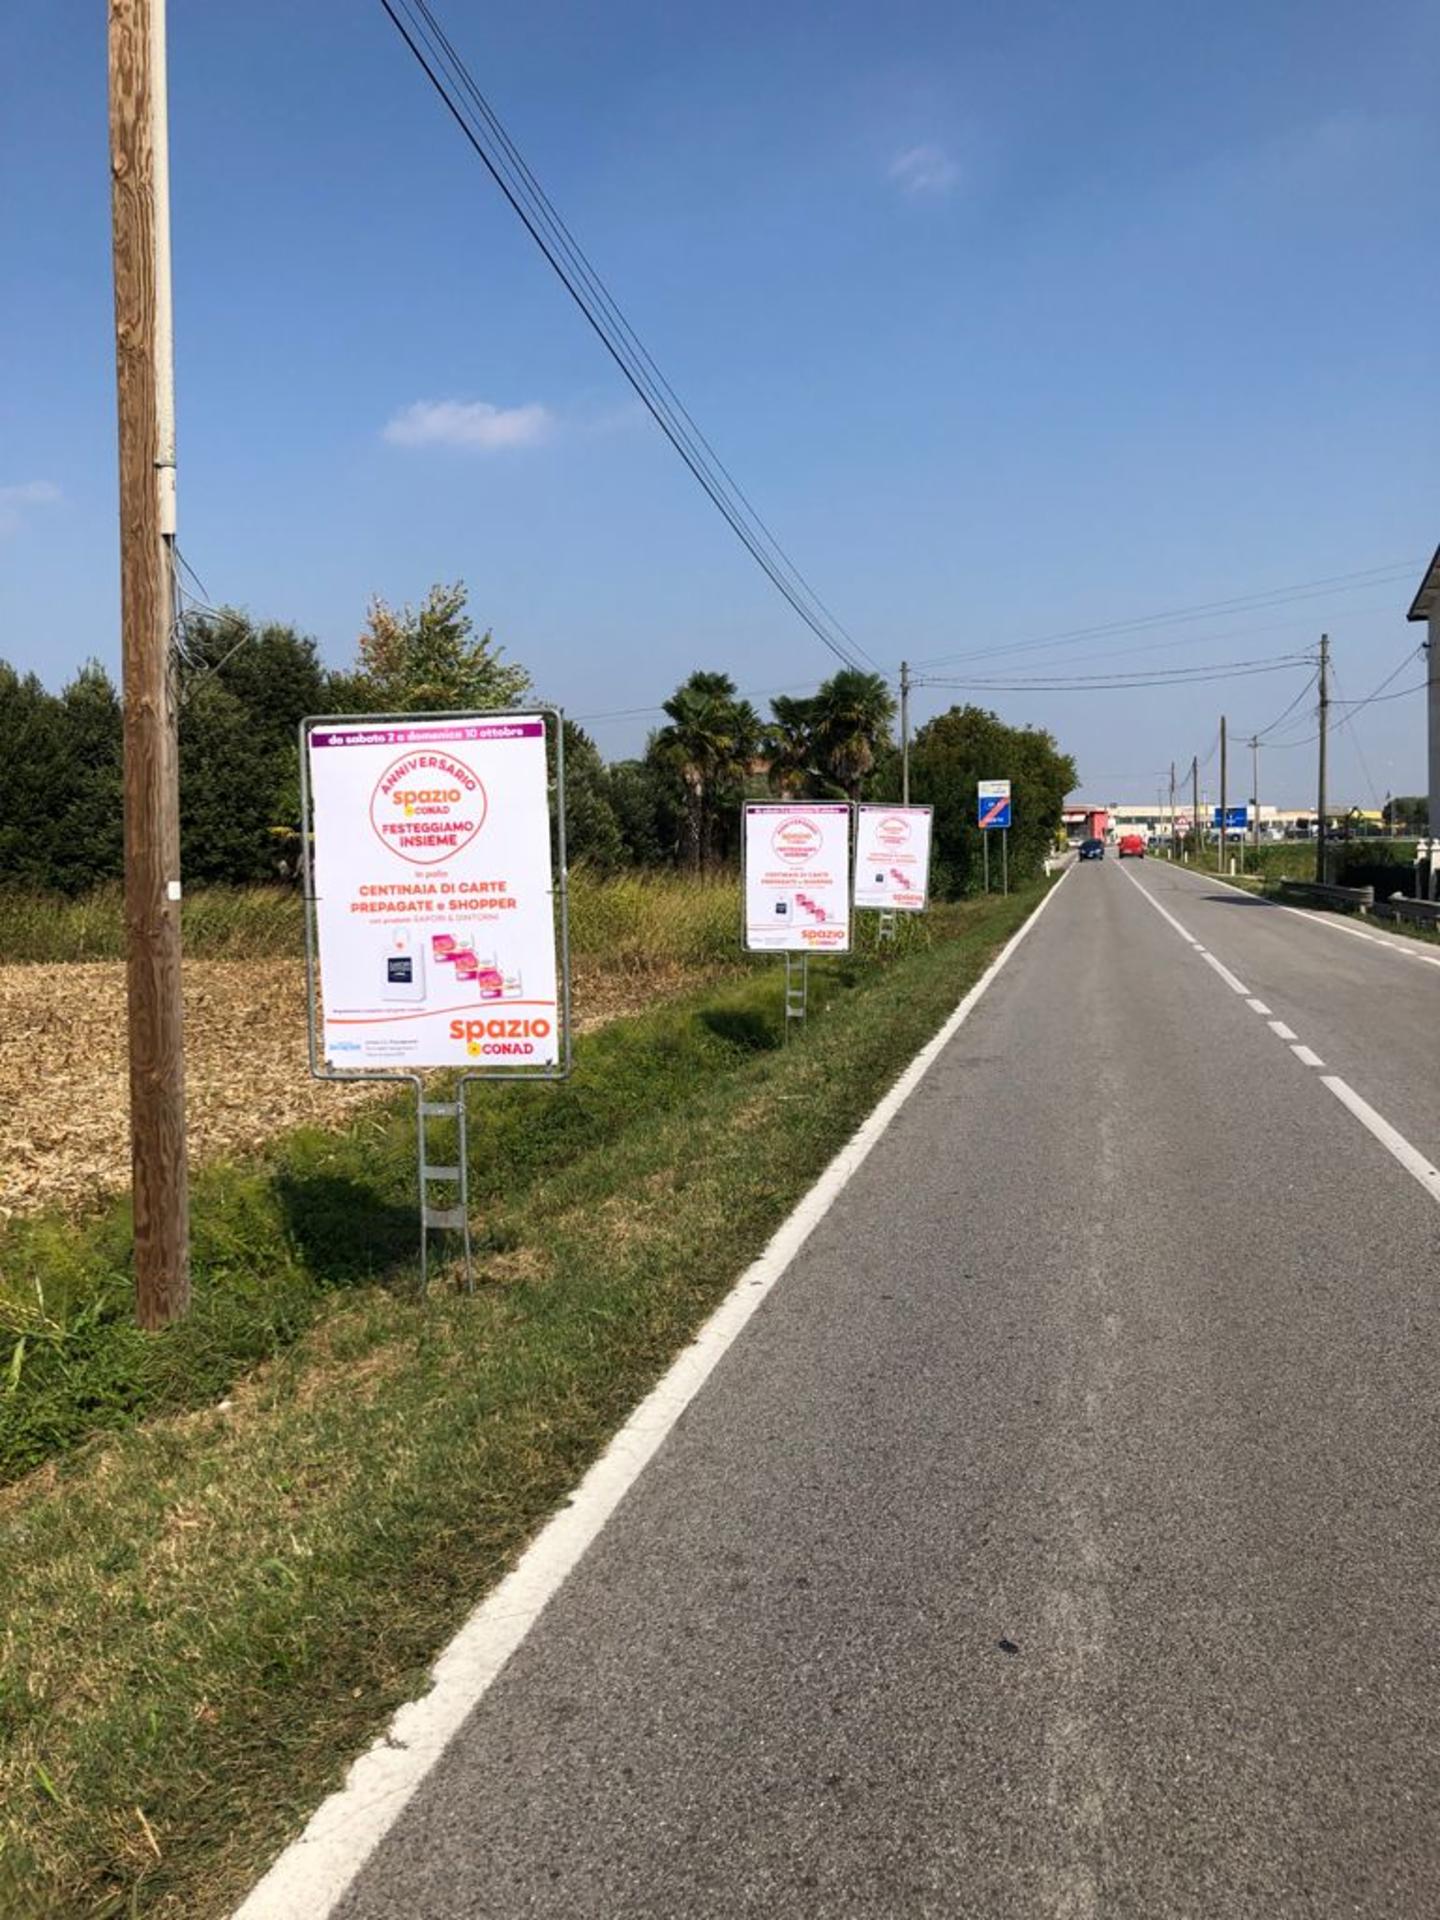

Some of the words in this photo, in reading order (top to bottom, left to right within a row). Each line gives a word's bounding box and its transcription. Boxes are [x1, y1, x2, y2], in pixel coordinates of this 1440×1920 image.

[328, 734, 344, 745] da
[346, 733, 386, 745] sabato
[387, 732, 395, 742] 2
[407, 730, 463, 742] domenica
[465, 729, 478, 738] 10
[479, 727, 524, 738] ottobre
[381, 756, 476, 795] ANNIVERSARIO
[392, 788, 461, 807] spazio
[414, 806, 451, 815] CONAD
[382, 820, 474, 834] FESTEGGIAMO
[400, 834, 458, 848] INSIEME
[359, 884, 437, 897] CENTINAIA
[439, 883, 455, 894] DI
[458, 881, 507, 894] CARTE
[351, 900, 434, 912] PREPAGATE
[436, 902, 446, 911] e
[448, 898, 517, 911] SHOPPER
[449, 1018, 550, 1043] spazio
[482, 1043, 534, 1055] CONAD
